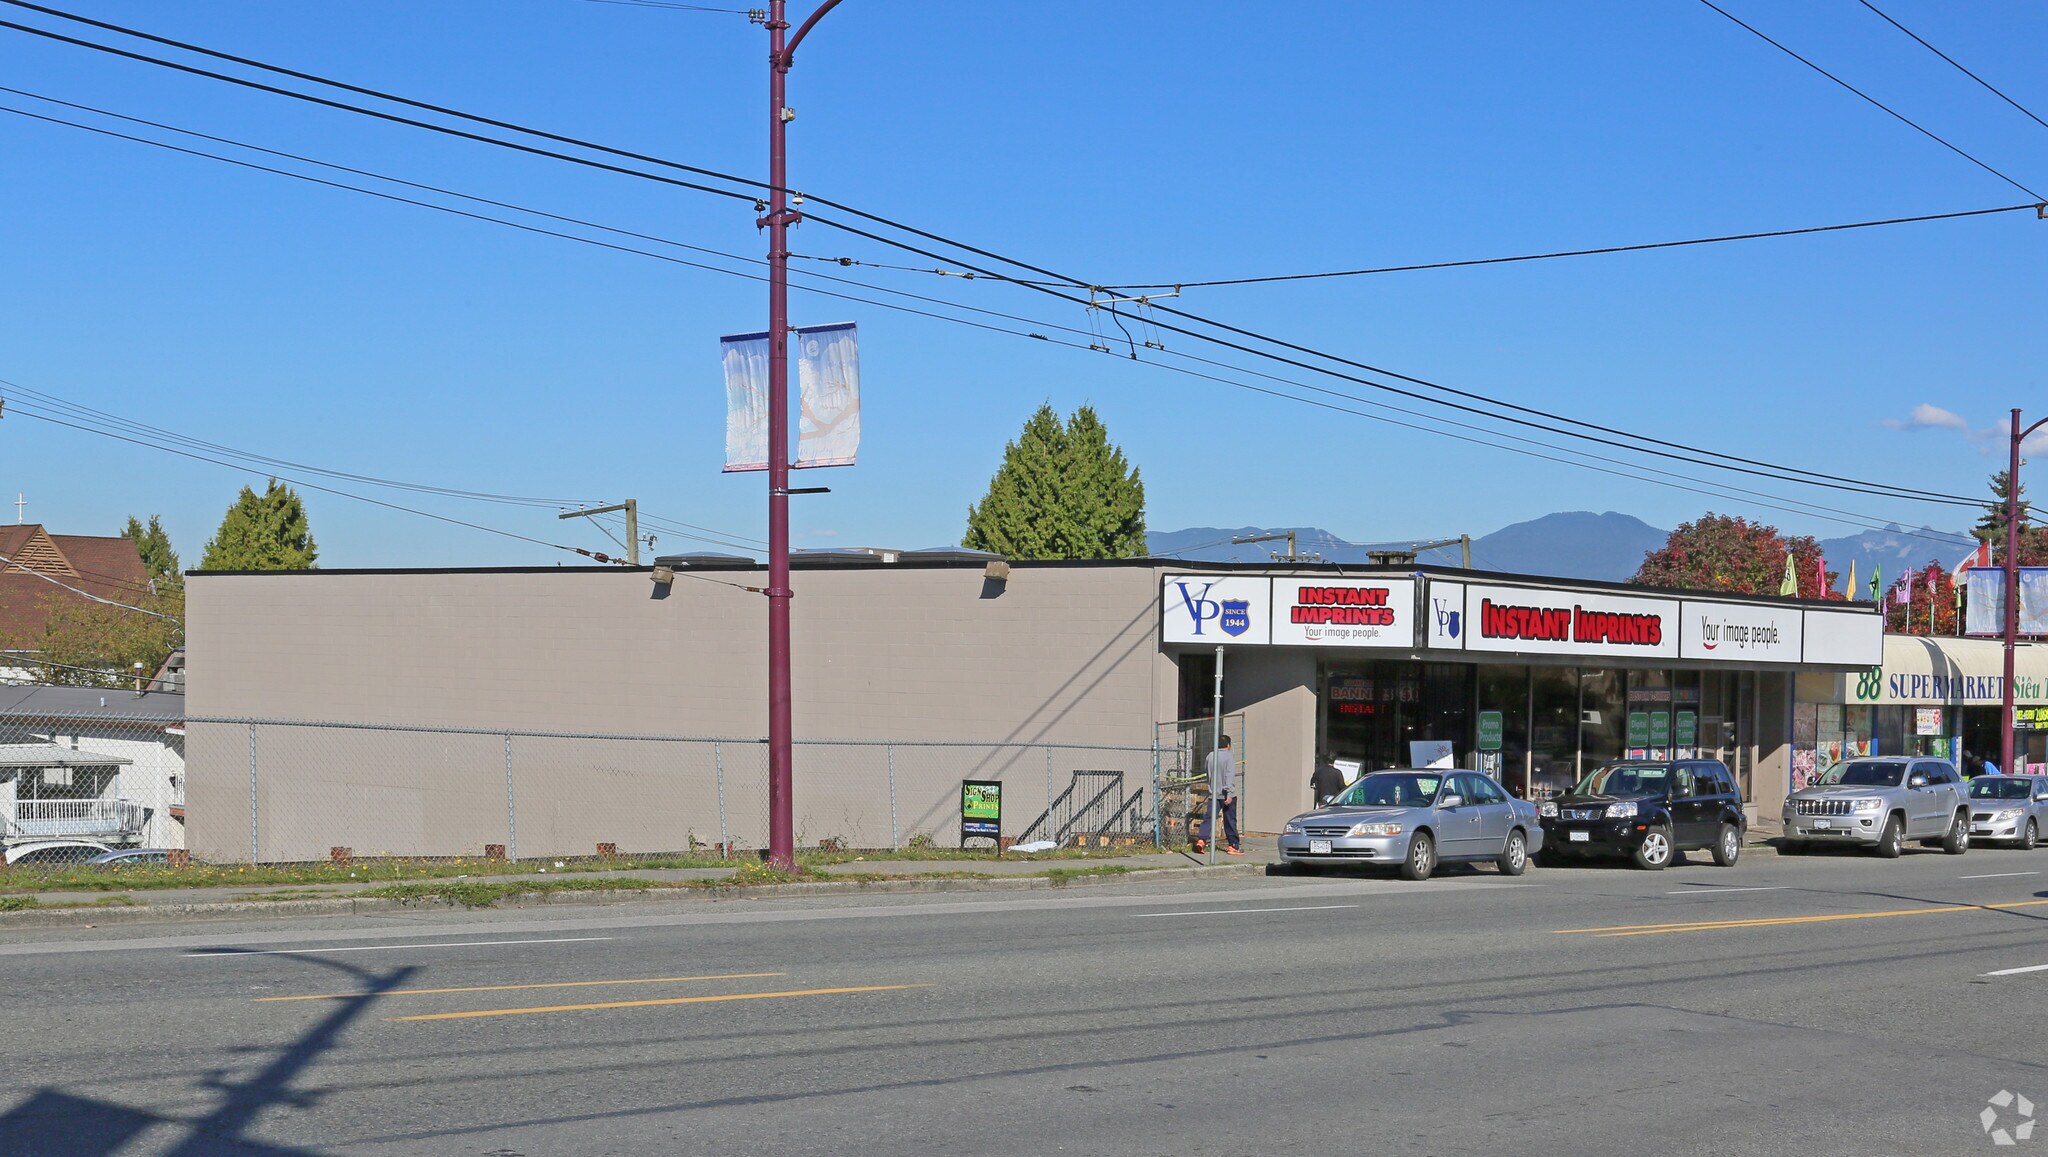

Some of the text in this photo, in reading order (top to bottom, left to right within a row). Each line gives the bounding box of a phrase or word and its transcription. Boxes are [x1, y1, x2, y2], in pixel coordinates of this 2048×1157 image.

[1298, 586, 1389, 606] INSTANT
[1225, 618, 1245, 627] 1944
[1291, 606, 1395, 626] IMPRINTS
[1481, 598, 1662, 646] INSTANT IMPRINTS
[1304, 626, 1382, 639] Your image people.
[1701, 615, 1781, 650] Your image people.
[1856, 666, 1882, 701] 88
[1889, 672, 2004, 700] SUPERMARKET
[2013, 675, 2040, 699] Siêu
[1482, 719, 1499, 729] Promo
[1479, 731, 1501, 742] Products
[981, 790, 1000, 803] SHOP
[973, 800, 999, 811] PRINTS
